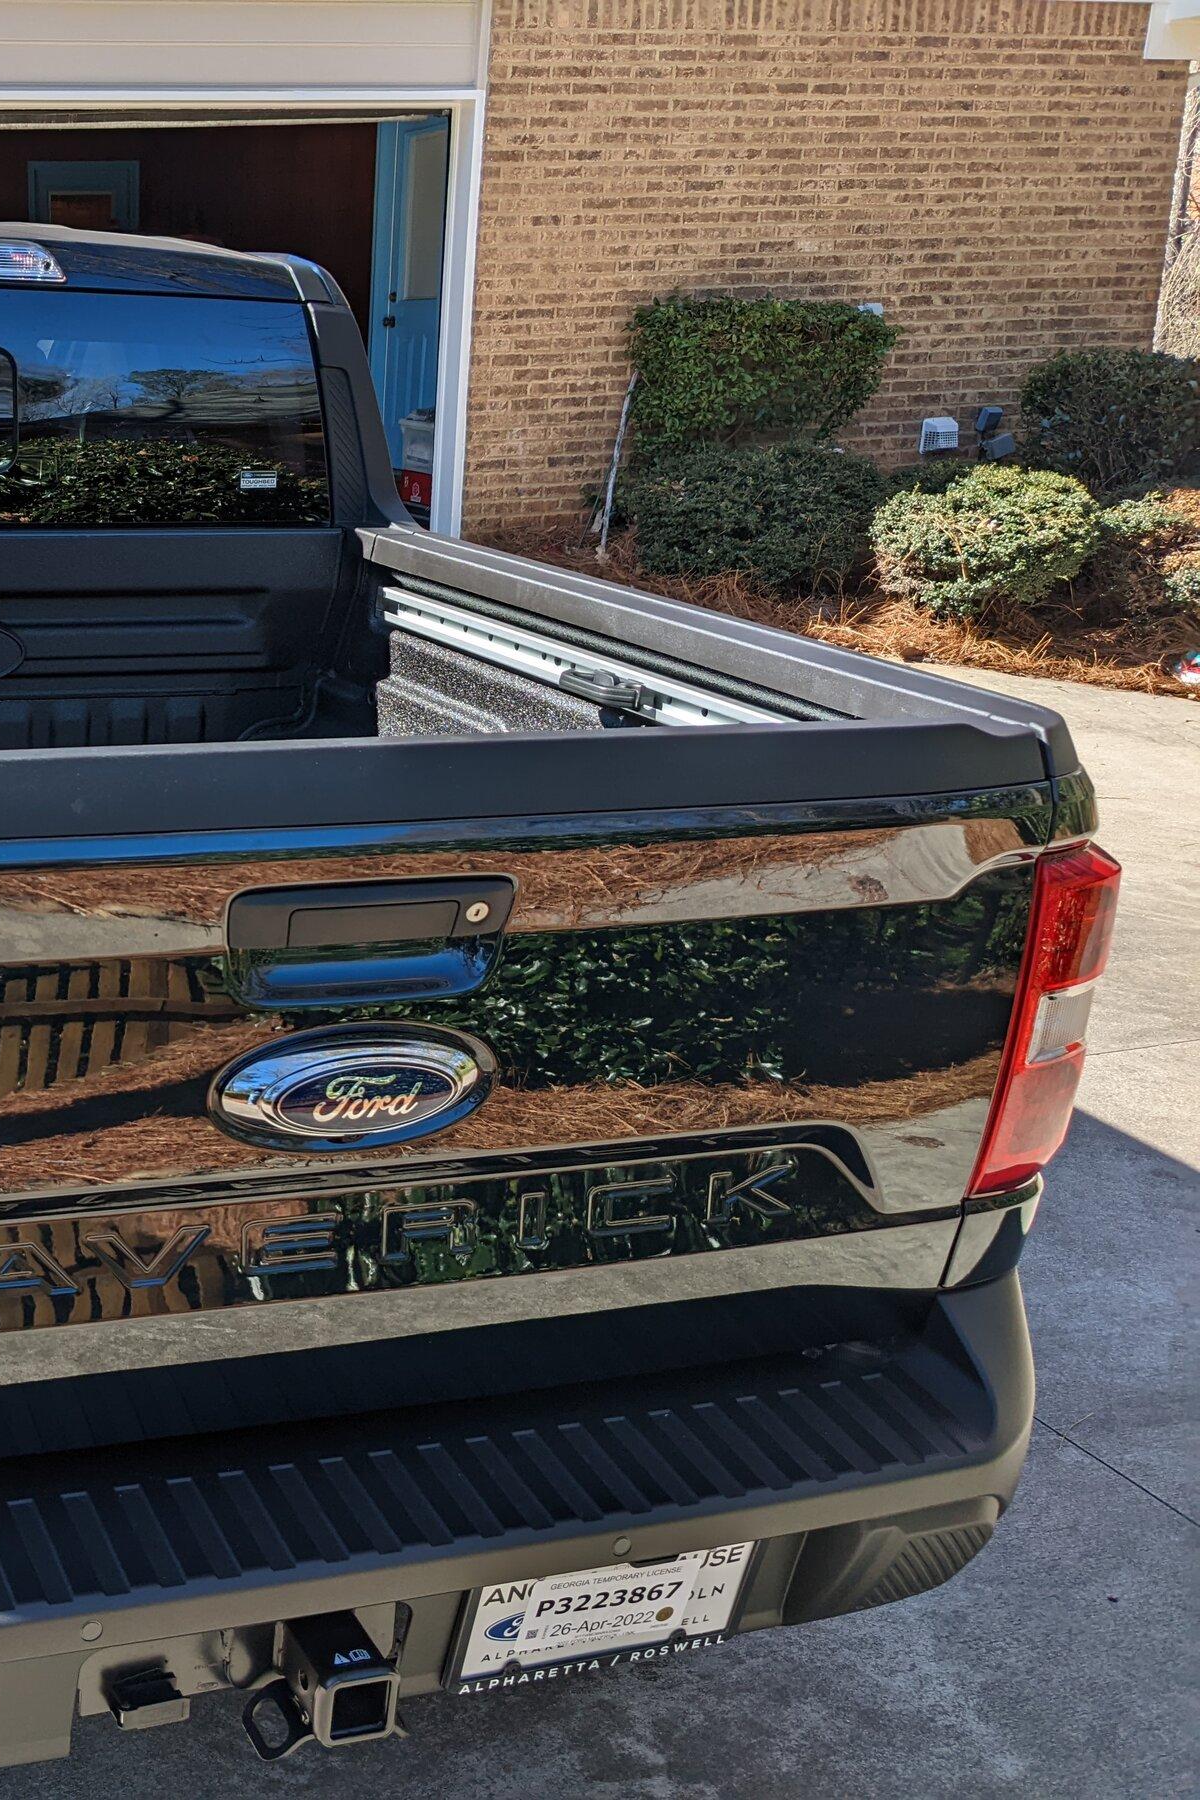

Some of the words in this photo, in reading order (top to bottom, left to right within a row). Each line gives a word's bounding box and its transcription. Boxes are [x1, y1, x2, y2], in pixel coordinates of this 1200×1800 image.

[312, 1073, 423, 1123] Ford
[550, 1578, 590, 1591] GEORGIA
[592, 1571, 645, 1584] TEMPORARY
[647, 1566, 684, 1577] LICENSE
[535, 1580, 684, 1618] P3223867
[550, 1610, 655, 1637] 26-Apr-2022
[458, 1659, 601, 1695] ALPHARETTA
[630, 1635, 726, 1663] ROSWELL
